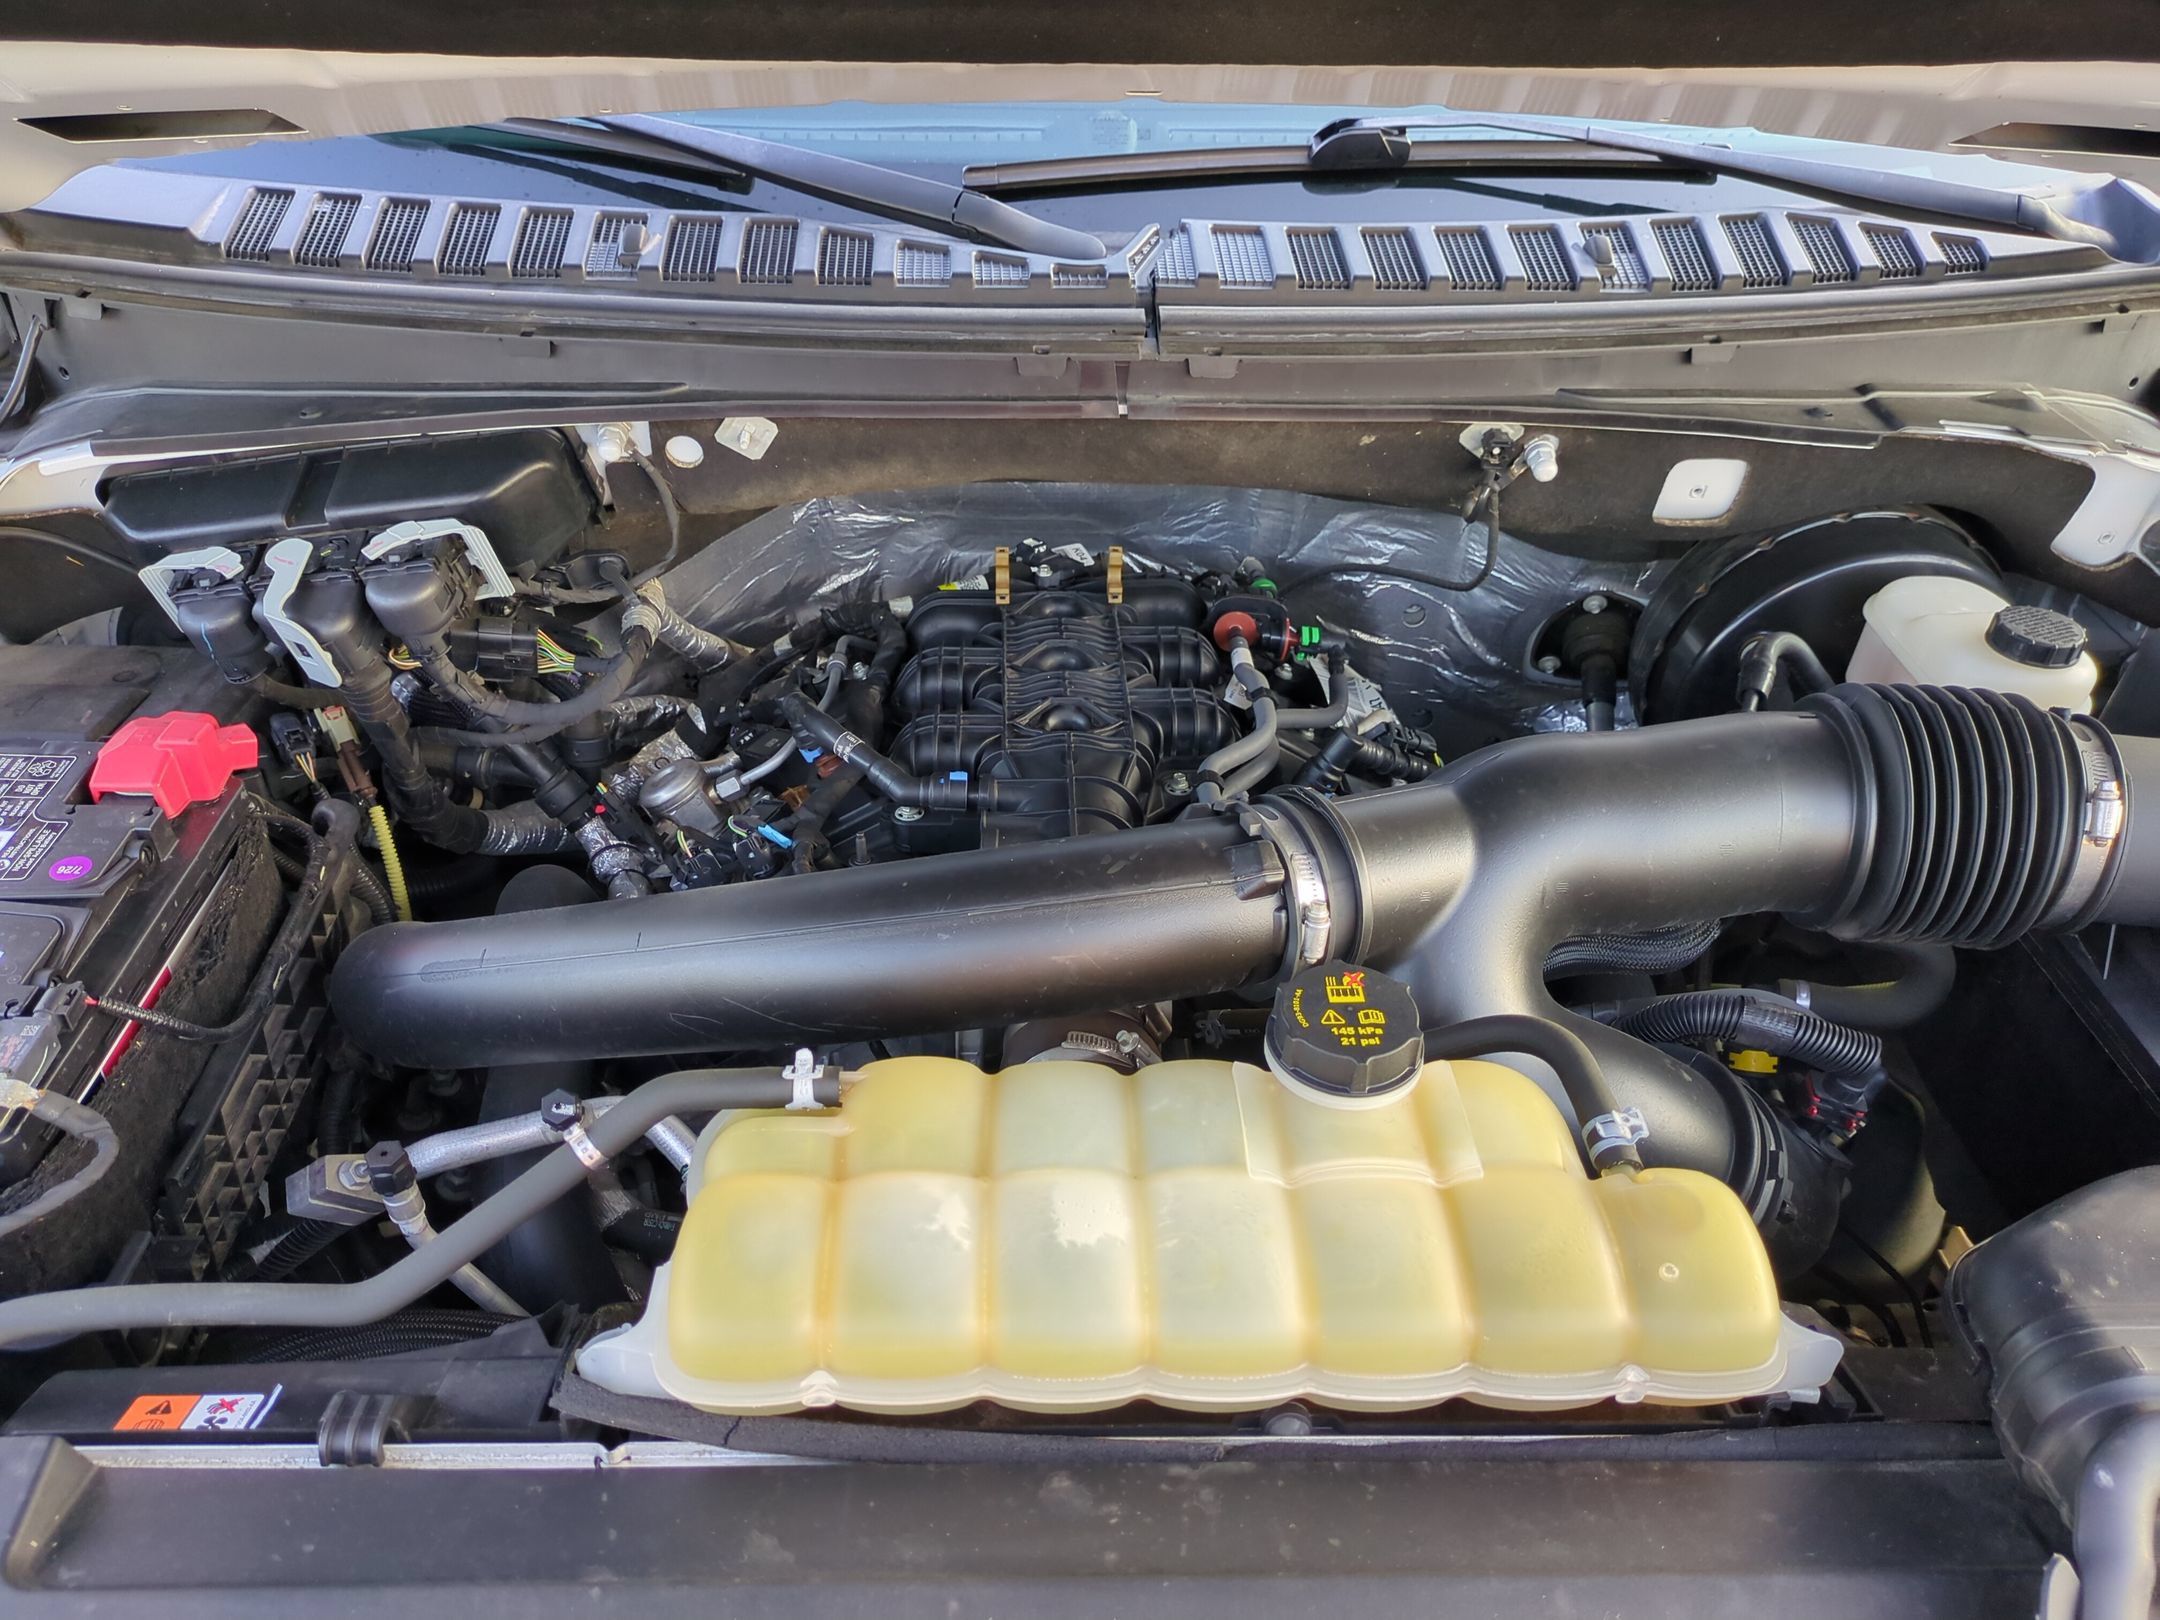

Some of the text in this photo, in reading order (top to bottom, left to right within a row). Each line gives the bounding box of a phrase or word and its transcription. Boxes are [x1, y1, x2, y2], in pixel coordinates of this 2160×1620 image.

[12, 829, 52, 872] NON-SPILLABLE
[56, 865, 83, 874] 7/26
[1331, 1026, 1384, 1035] 145 kPa
[1340, 1036, 1380, 1047] 21 psi
